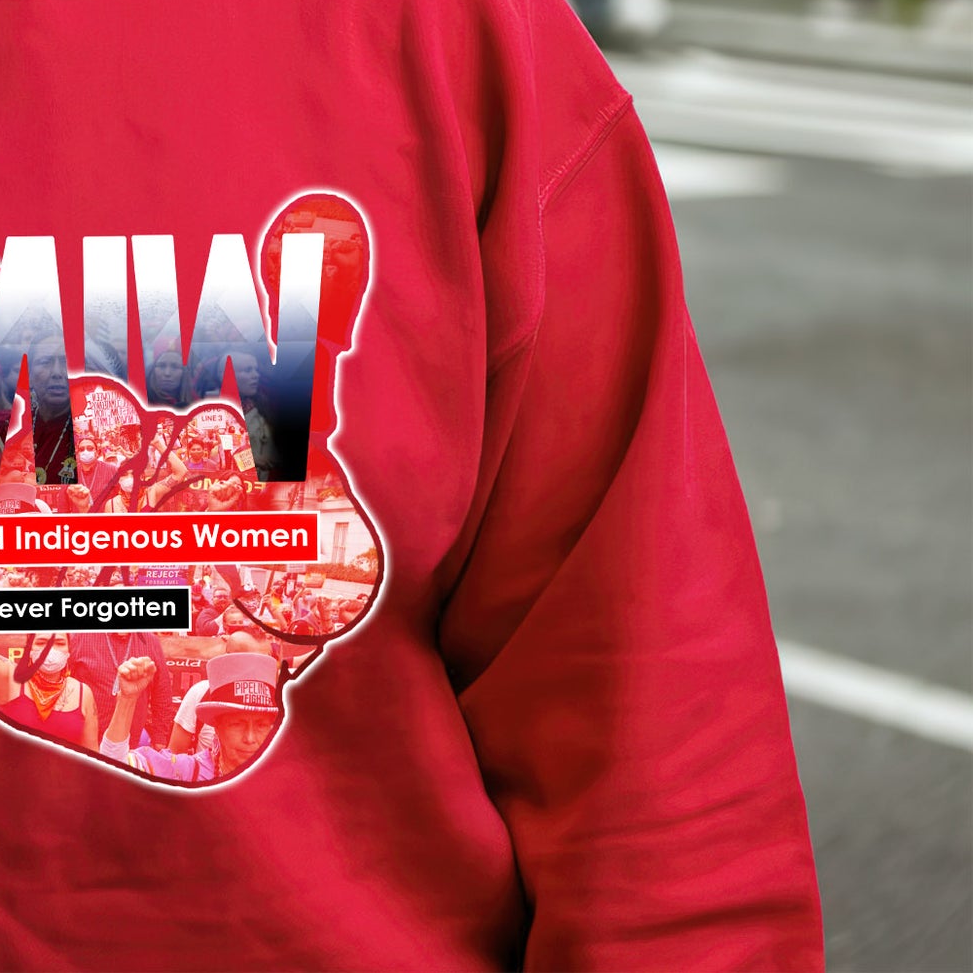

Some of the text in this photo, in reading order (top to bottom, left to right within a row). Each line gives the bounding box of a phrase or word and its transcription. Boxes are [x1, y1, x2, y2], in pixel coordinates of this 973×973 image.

[15, 522, 183, 556] Indigenous
[193, 523, 309, 548] Women
[146, 570, 180, 578] REJECT
[61, 595, 177, 624] Forgotten
[165, 659, 202, 667] ould
